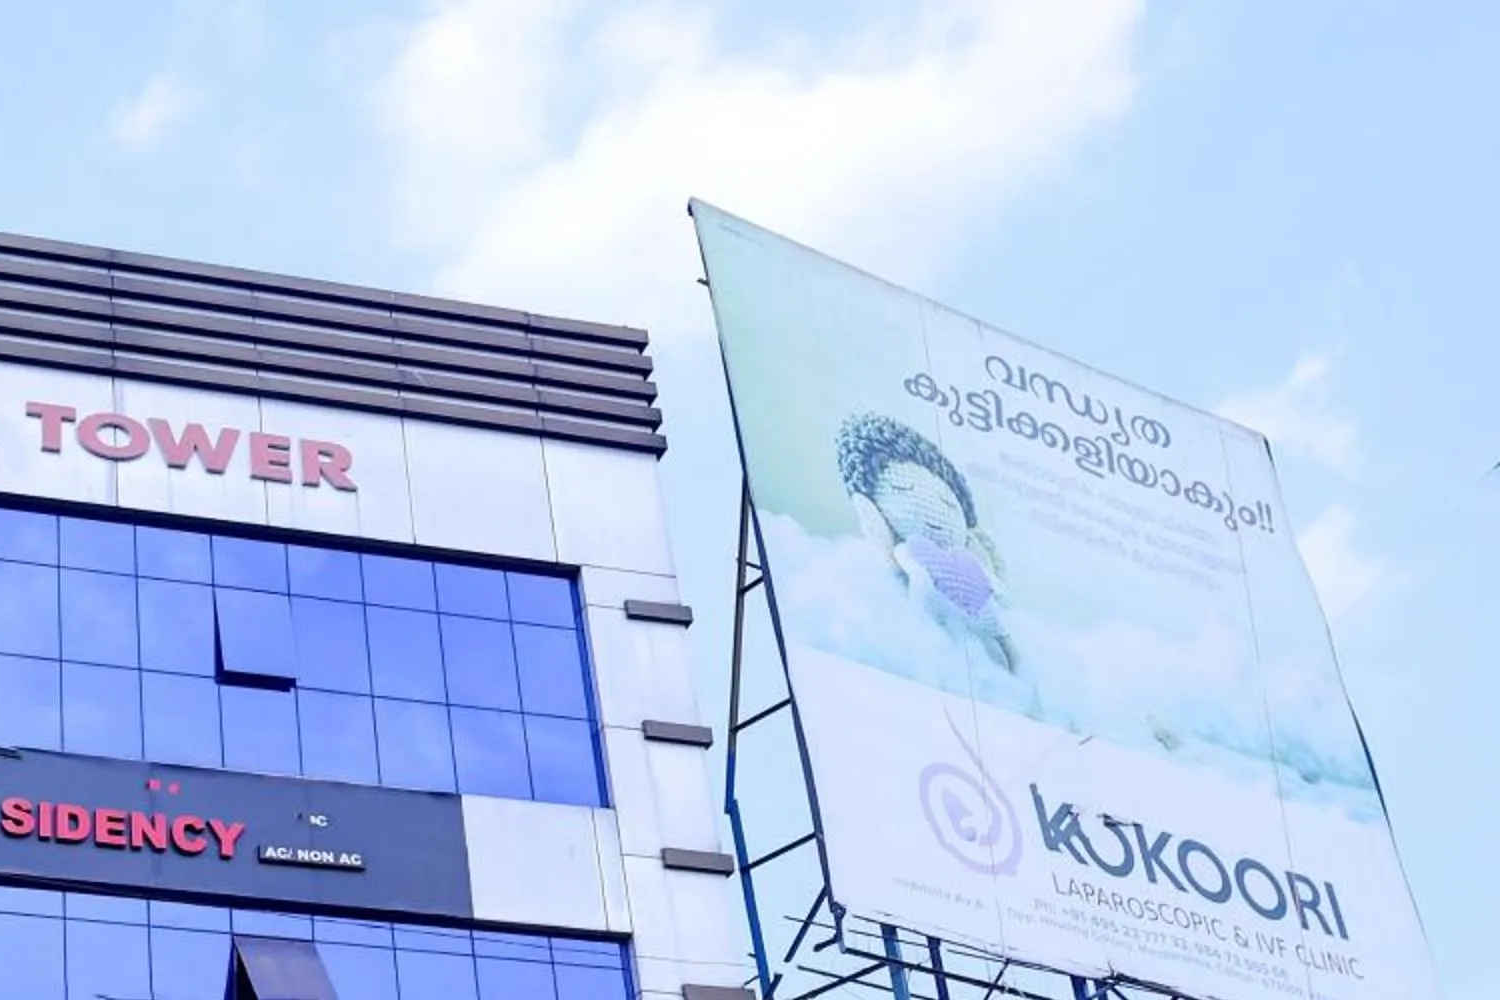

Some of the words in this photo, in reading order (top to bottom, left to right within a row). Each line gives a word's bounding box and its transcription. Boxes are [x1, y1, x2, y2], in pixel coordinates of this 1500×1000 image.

[26, 401, 358, 493] TOWER
[297, 849, 335, 863] NON
[340, 853, 362, 865] AC
[1051, 872, 1228, 942] LAPAROSCOPIC
[1233, 926, 1249, 948] &
[1255, 931, 1288, 958] IVF
[1295, 943, 1365, 980] CLINIC
